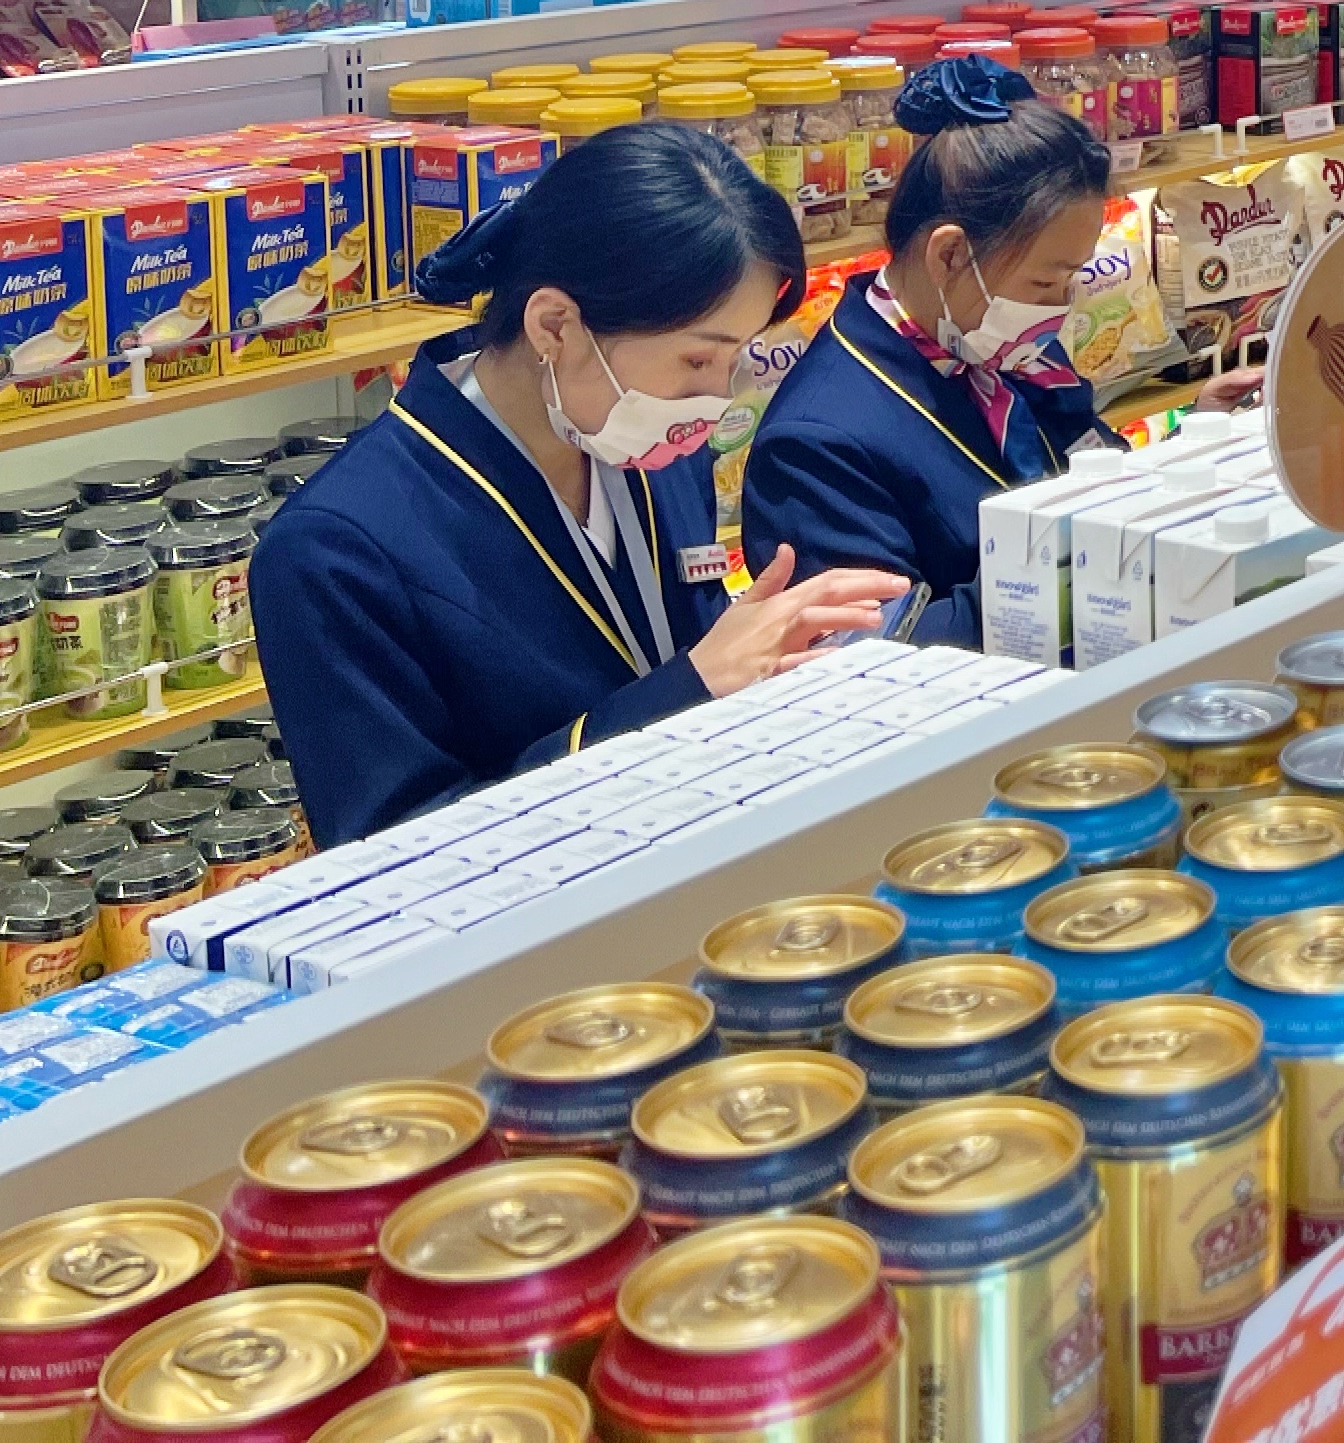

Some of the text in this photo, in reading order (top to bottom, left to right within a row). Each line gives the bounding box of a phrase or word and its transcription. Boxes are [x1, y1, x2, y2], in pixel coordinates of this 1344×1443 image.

[251, 224, 305, 253] Milk Tea
[130, 243, 188, 273] Milk Tea
[1, 262, 62, 295] Milk Tea
